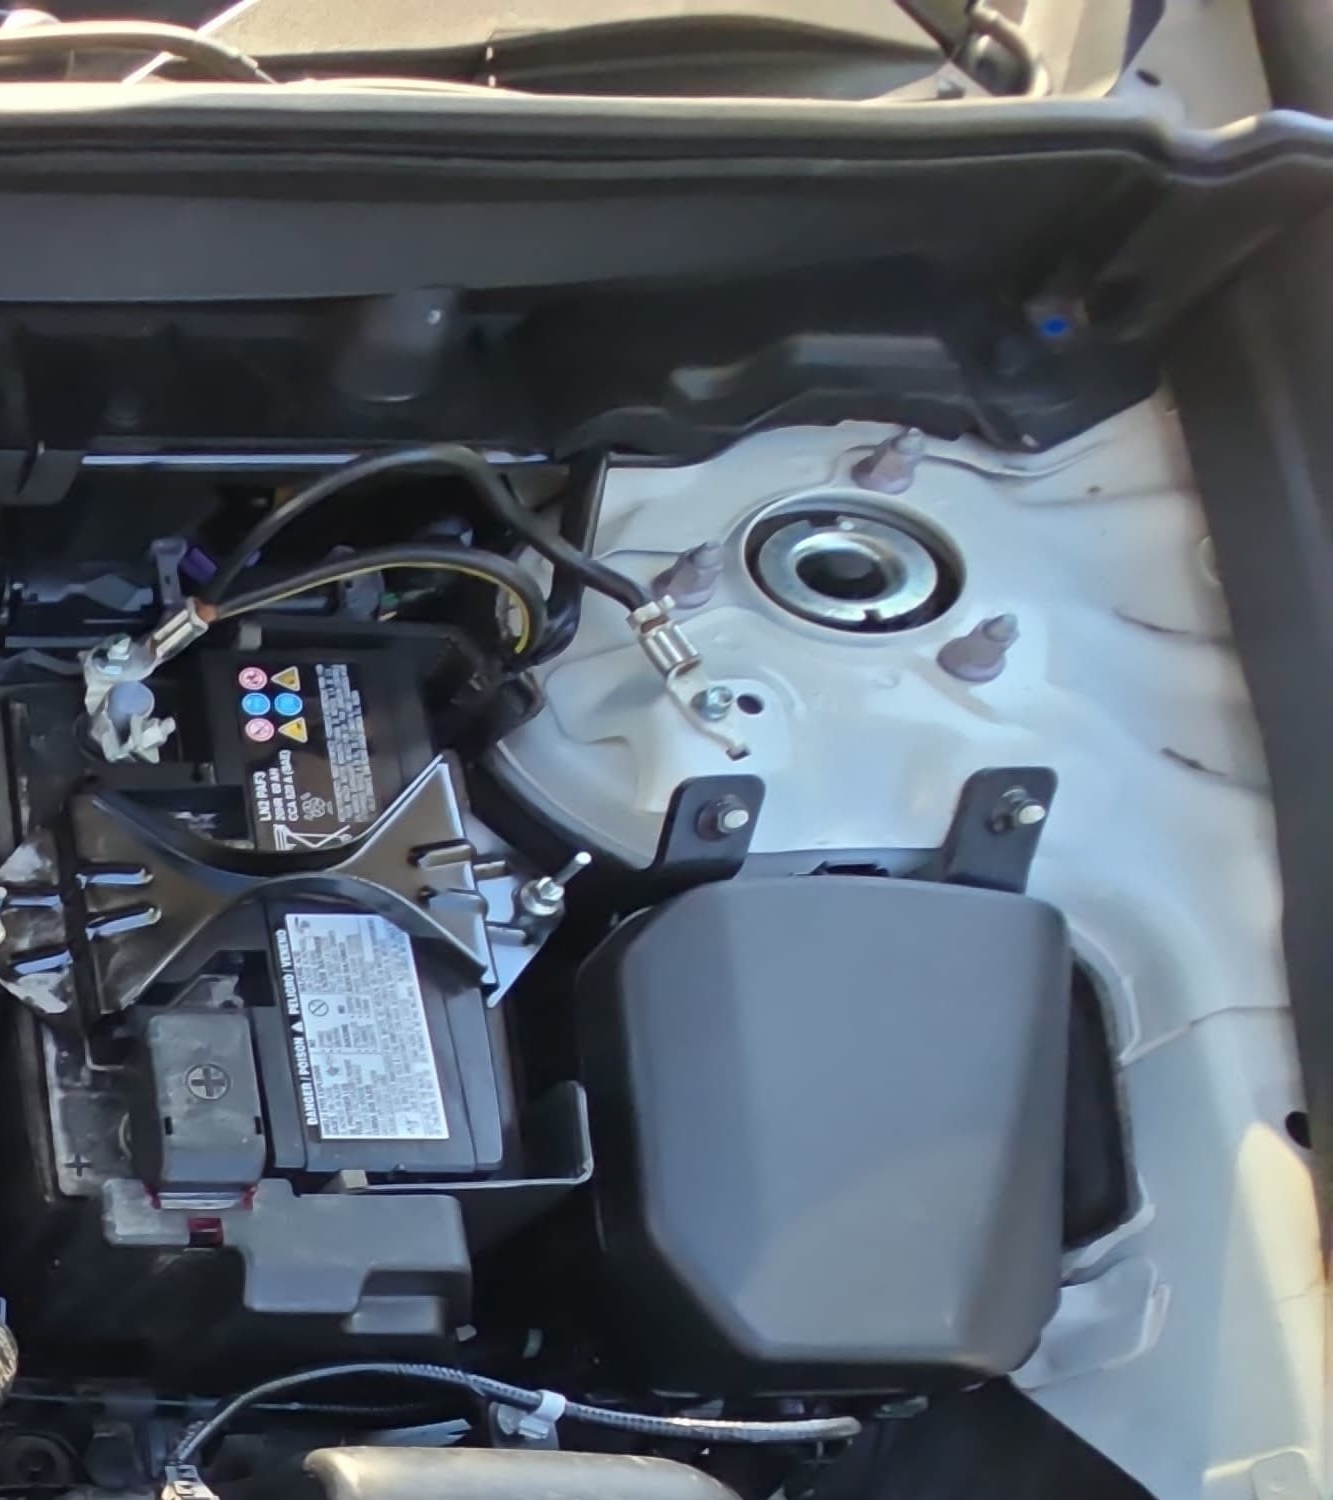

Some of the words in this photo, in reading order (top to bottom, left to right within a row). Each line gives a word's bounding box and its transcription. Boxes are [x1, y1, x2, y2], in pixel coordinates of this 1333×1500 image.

[257, 801, 272, 822] LN2
[287, 800, 299, 822] CCA
[275, 929, 293, 968] VENENO
[283, 974, 300, 1015] PELIGRO
[292, 1036, 310, 1075] POISON
[301, 1082, 318, 1126] DANGER
